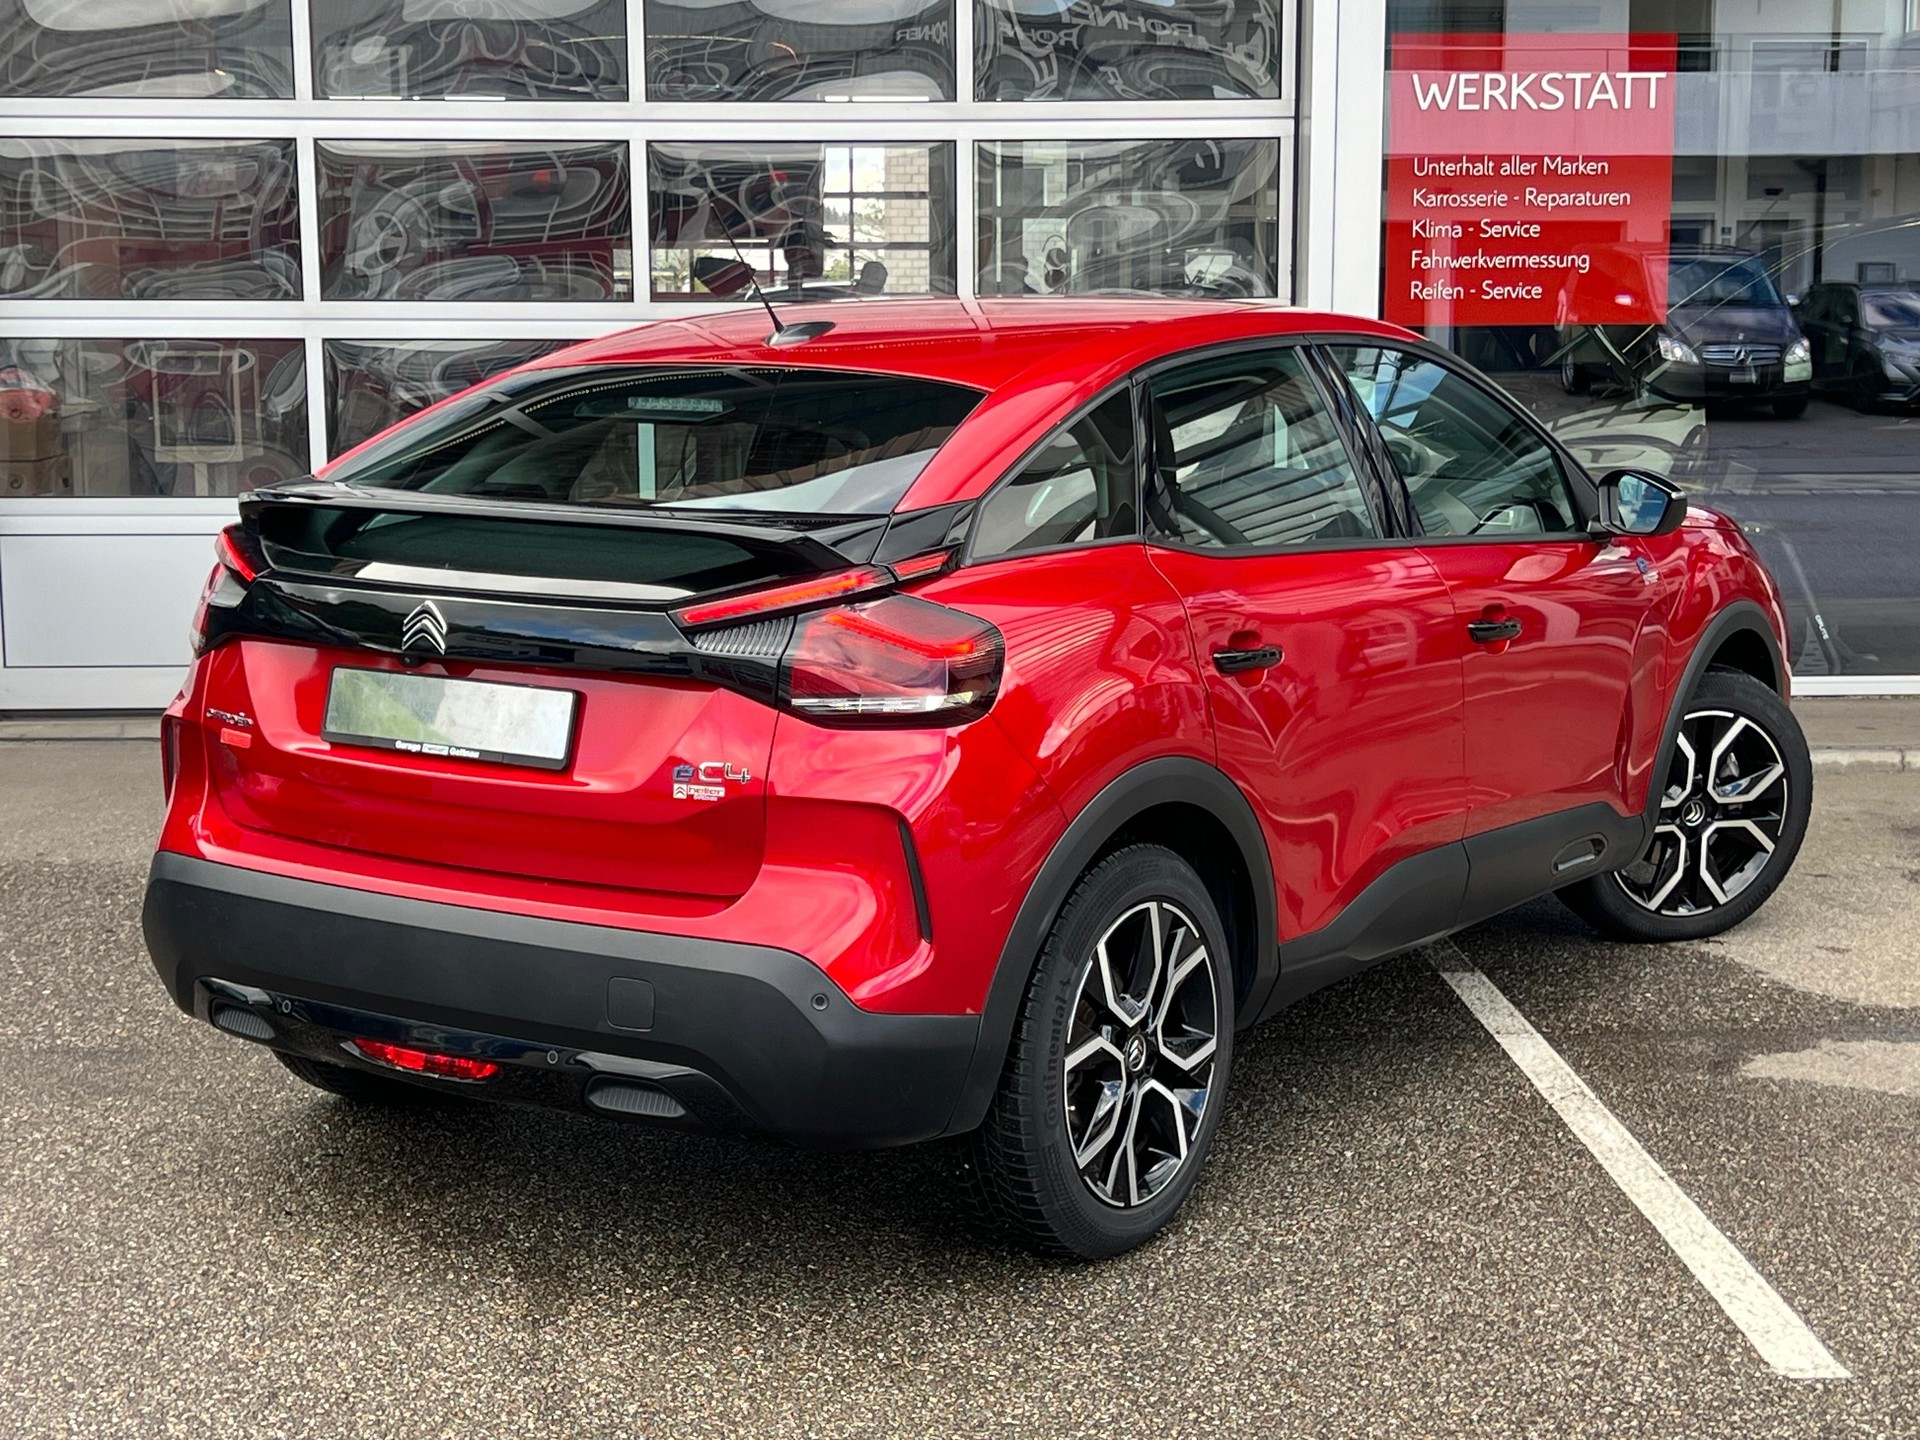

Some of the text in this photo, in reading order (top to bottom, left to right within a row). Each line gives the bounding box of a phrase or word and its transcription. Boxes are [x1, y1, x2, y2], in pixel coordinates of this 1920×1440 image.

[1412, 72, 1667, 111] WERKSTATT
[1413, 155, 1609, 176] Unterhalt aller Marken
[1413, 188, 1508, 207] Karrosserie
[1525, 187, 1630, 211] Reparaturen
[1412, 219, 1462, 238] Klima
[1480, 218, 1541, 237] Service
[1411, 249, 1590, 273] Fahrwerkvermessung
[1410, 280, 1464, 300] Reifen
[1481, 280, 1543, 299] Service
